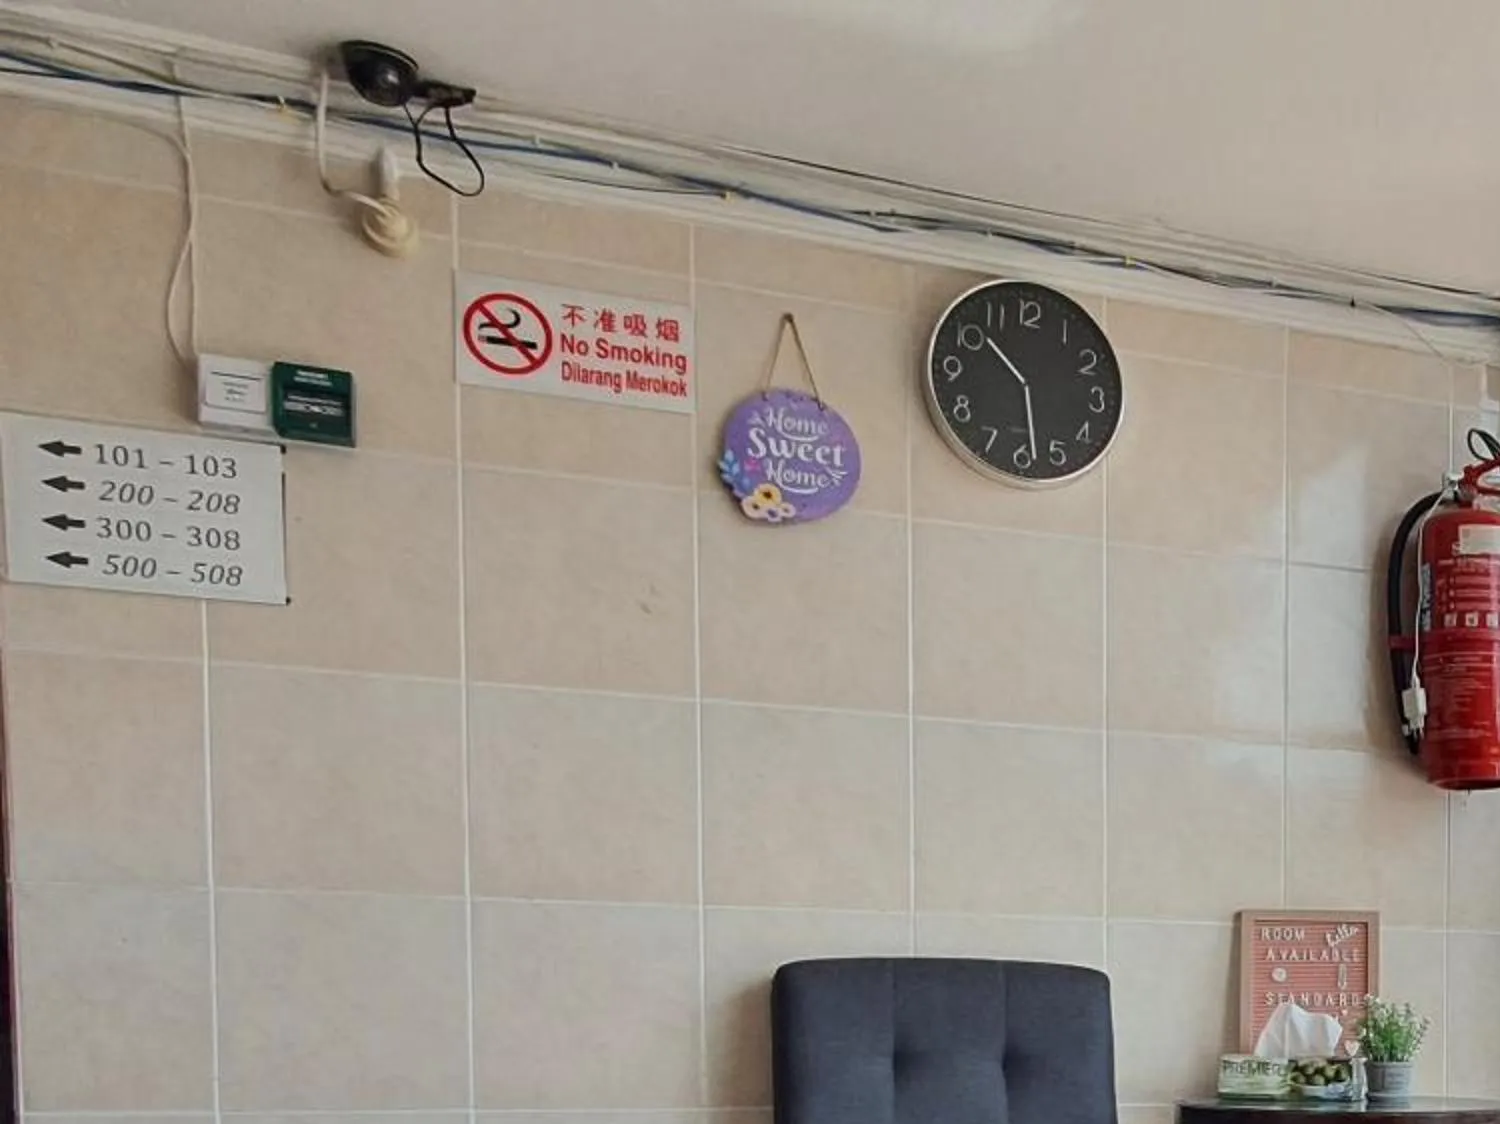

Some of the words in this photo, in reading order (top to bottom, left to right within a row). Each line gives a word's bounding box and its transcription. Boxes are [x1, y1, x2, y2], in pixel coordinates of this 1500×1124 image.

[560, 303, 680, 343] 不准吸烟
[986, 302, 1005, 330] 11
[1019, 299, 1041, 329] 12
[956, 321, 985, 351] 10
[1062, 319, 1068, 345] 1
[560, 333, 589, 357] No
[595, 338, 688, 376] Smoking
[943, 355, 963, 381] 9
[1078, 348, 1097, 376] 2
[560, 361, 623, 394] Dilarang
[953, 394, 971, 423] 8
[1088, 386, 1105, 413] 3
[766, 406, 830, 441] Home
[1075, 421, 1091, 443] 4
[748, 427, 845, 467] Sweet
[981, 426, 998, 453] 7
[1049, 440, 1067, 466] 5
[95, 443, 147, 470] 101
[185, 455, 238, 480] 103
[1013, 444, 1031, 469] 6
[766, 458, 830, 494] Home
[99, 480, 155, 507] 200
[187, 489, 241, 516] 208
[95, 516, 152, 543] 300
[186, 525, 241, 552] 308
[102, 554, 157, 580] 500
[190, 562, 244, 588] 508
[1261, 927, 1305, 941] ROOM
[1265, 948, 1361, 962] AVAILABLE
[1265, 991, 1360, 1007] STANDARD
